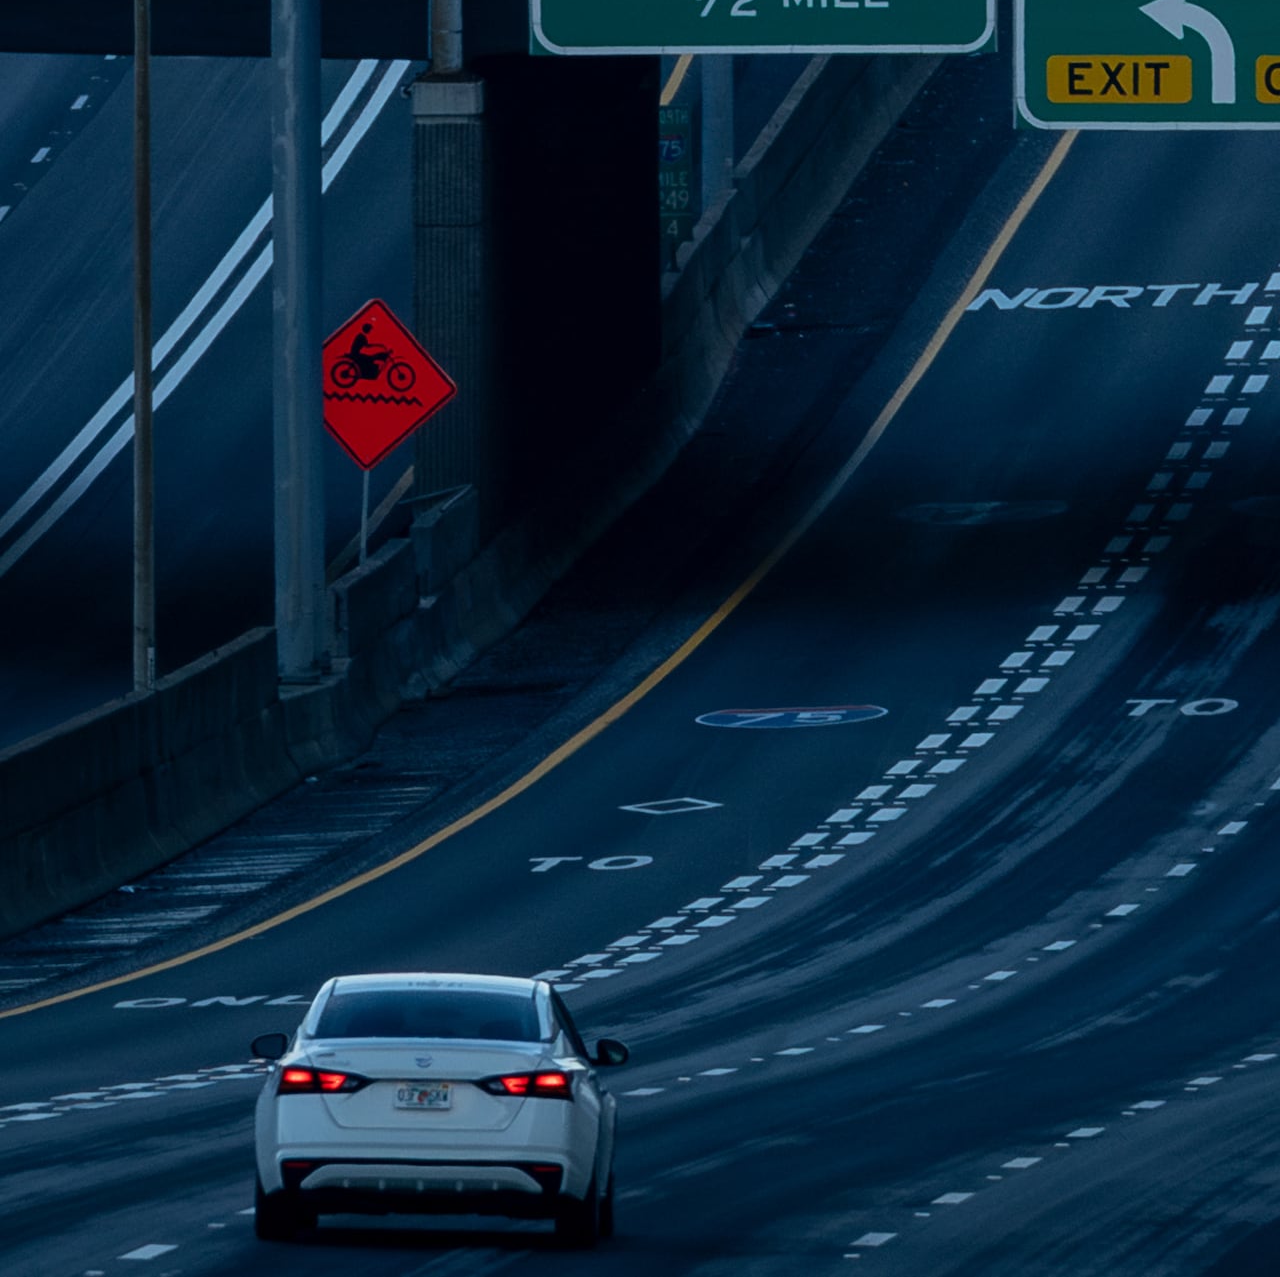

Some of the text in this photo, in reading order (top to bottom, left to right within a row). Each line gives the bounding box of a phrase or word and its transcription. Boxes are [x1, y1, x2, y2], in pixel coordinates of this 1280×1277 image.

[1068, 63, 1170, 95] EXIT
[963, 281, 1262, 313] NORTH
[1126, 697, 1240, 717] TO
[530, 856, 653, 872] TO
